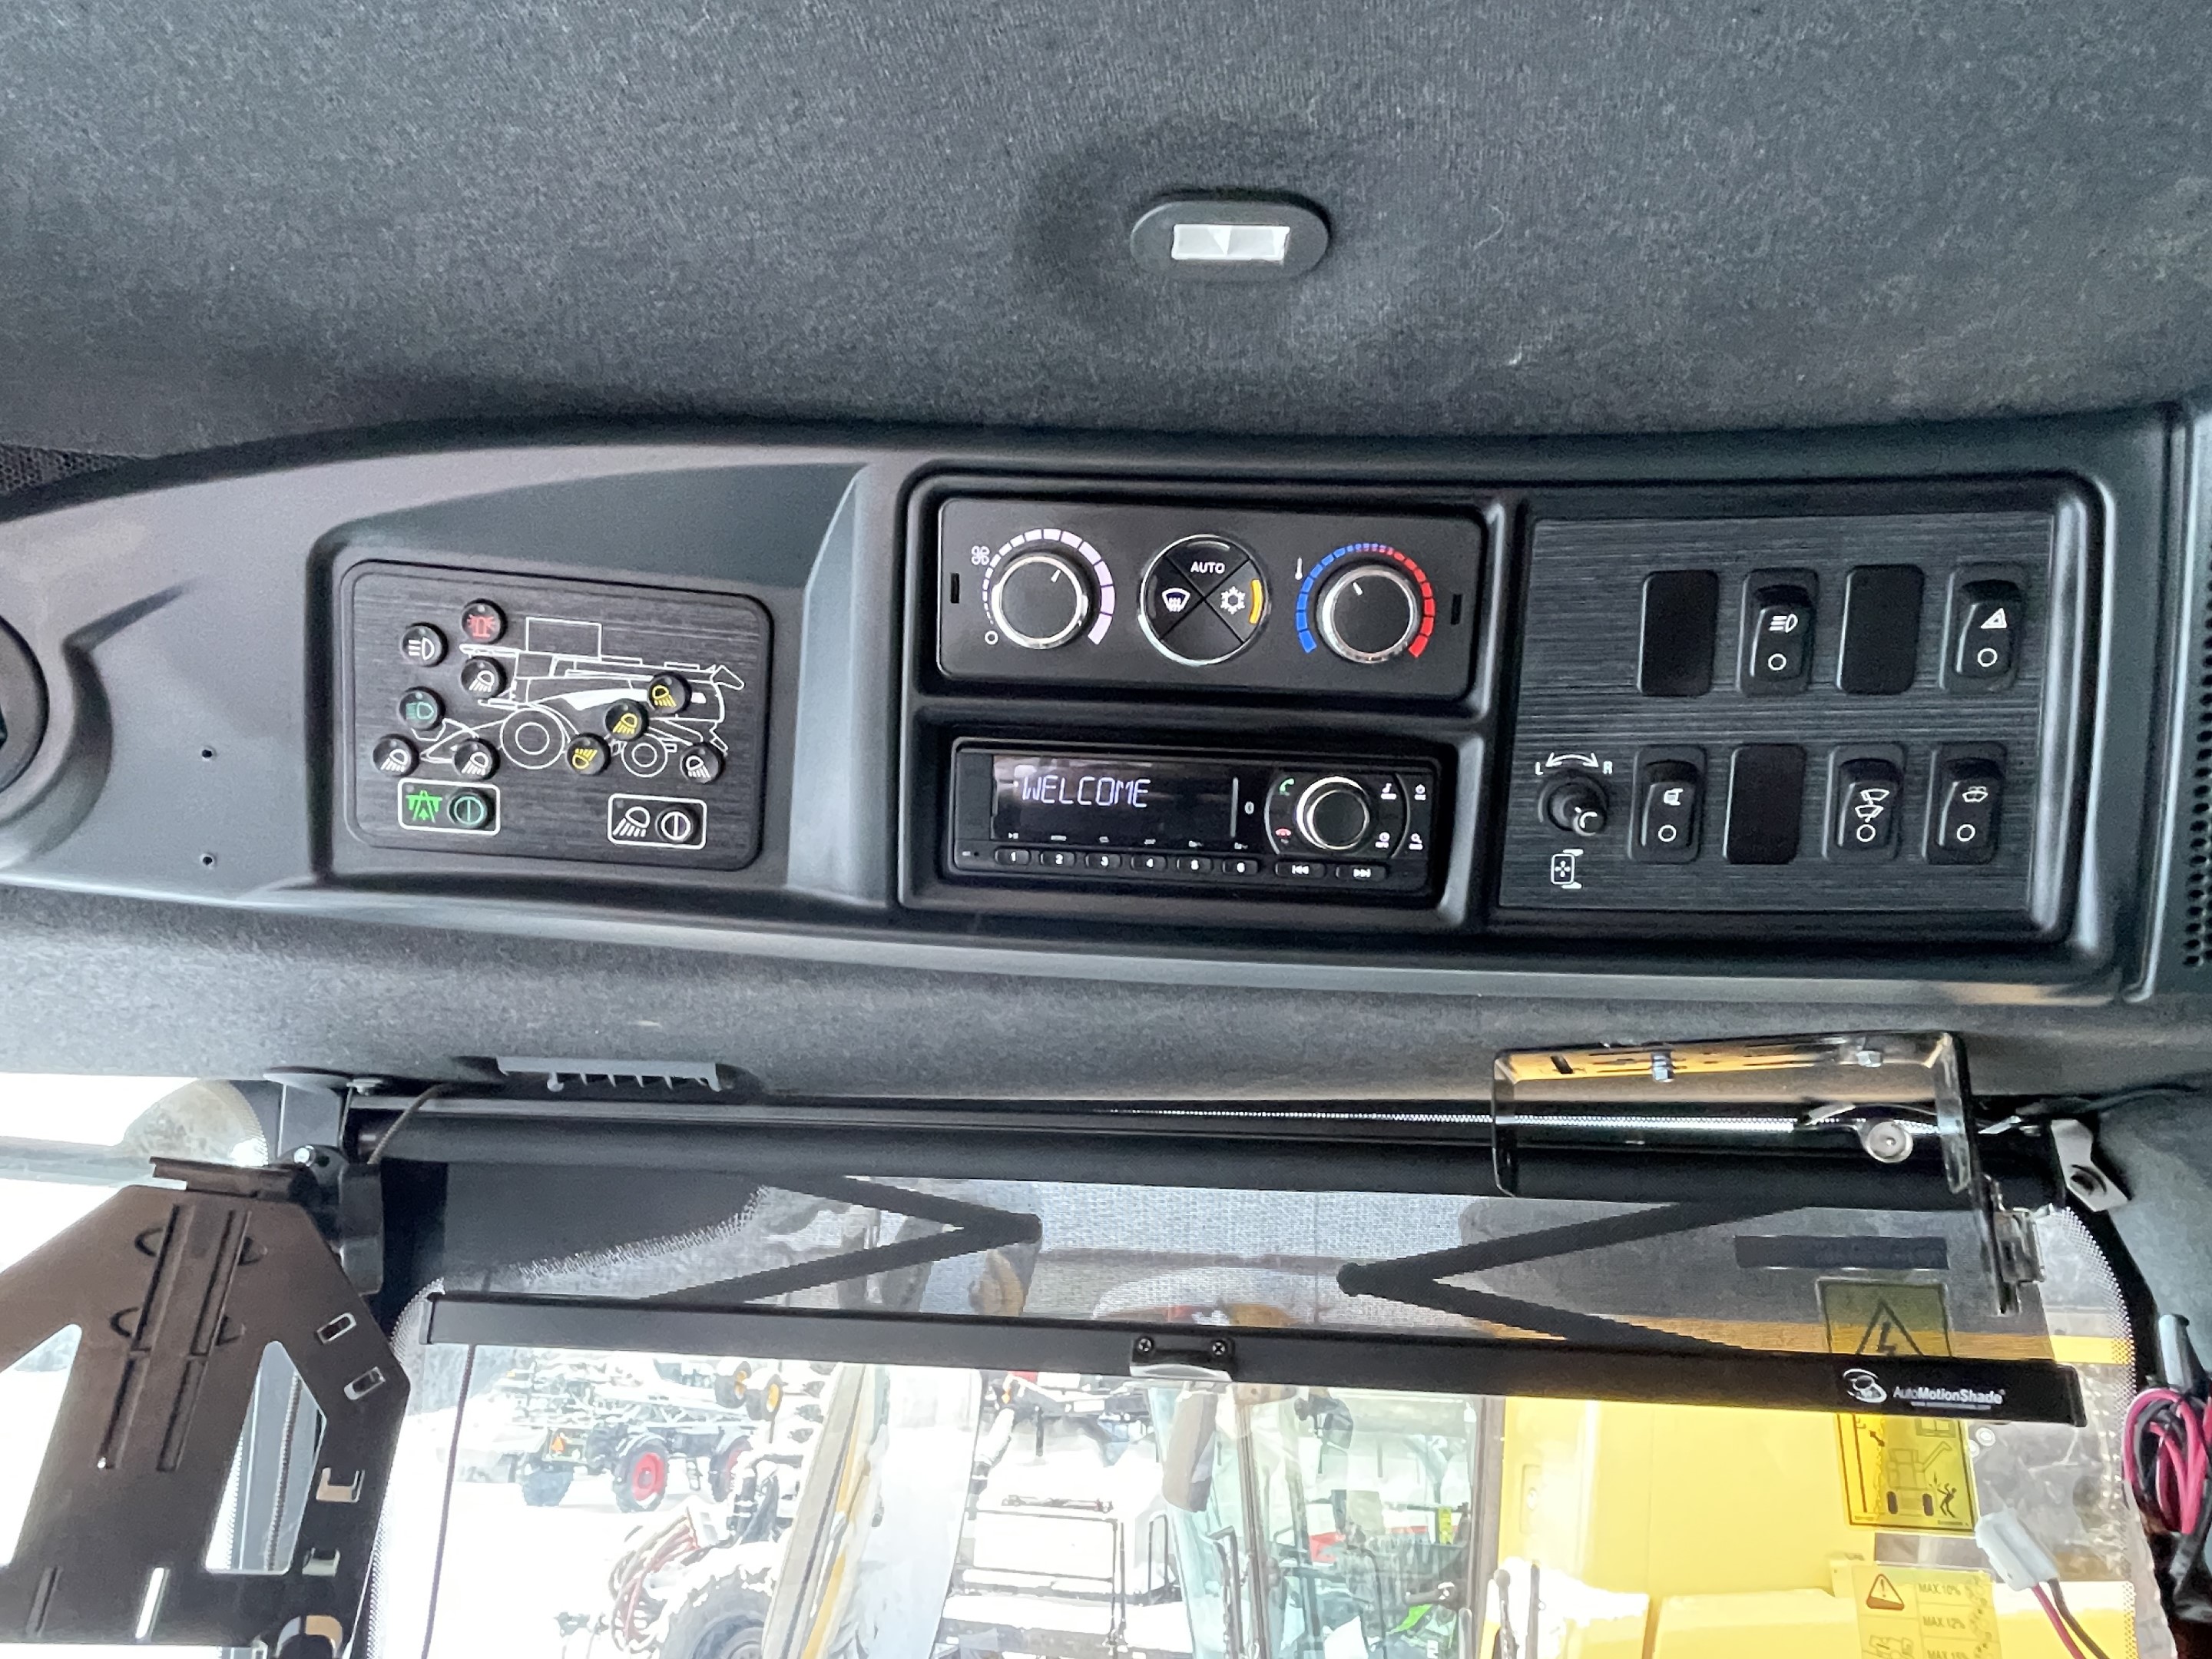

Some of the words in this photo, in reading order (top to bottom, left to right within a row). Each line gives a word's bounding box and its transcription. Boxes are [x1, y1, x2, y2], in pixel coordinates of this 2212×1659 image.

[1190, 561, 1226, 575] AUTO
[1535, 761, 1544, 776] L
[1602, 760, 1613, 775] R
[1022, 774, 1151, 808] WELCOME
[1010, 851, 1016, 862] 1
[1055, 853, 1064, 865] 2
[1101, 856, 1109, 867] 3
